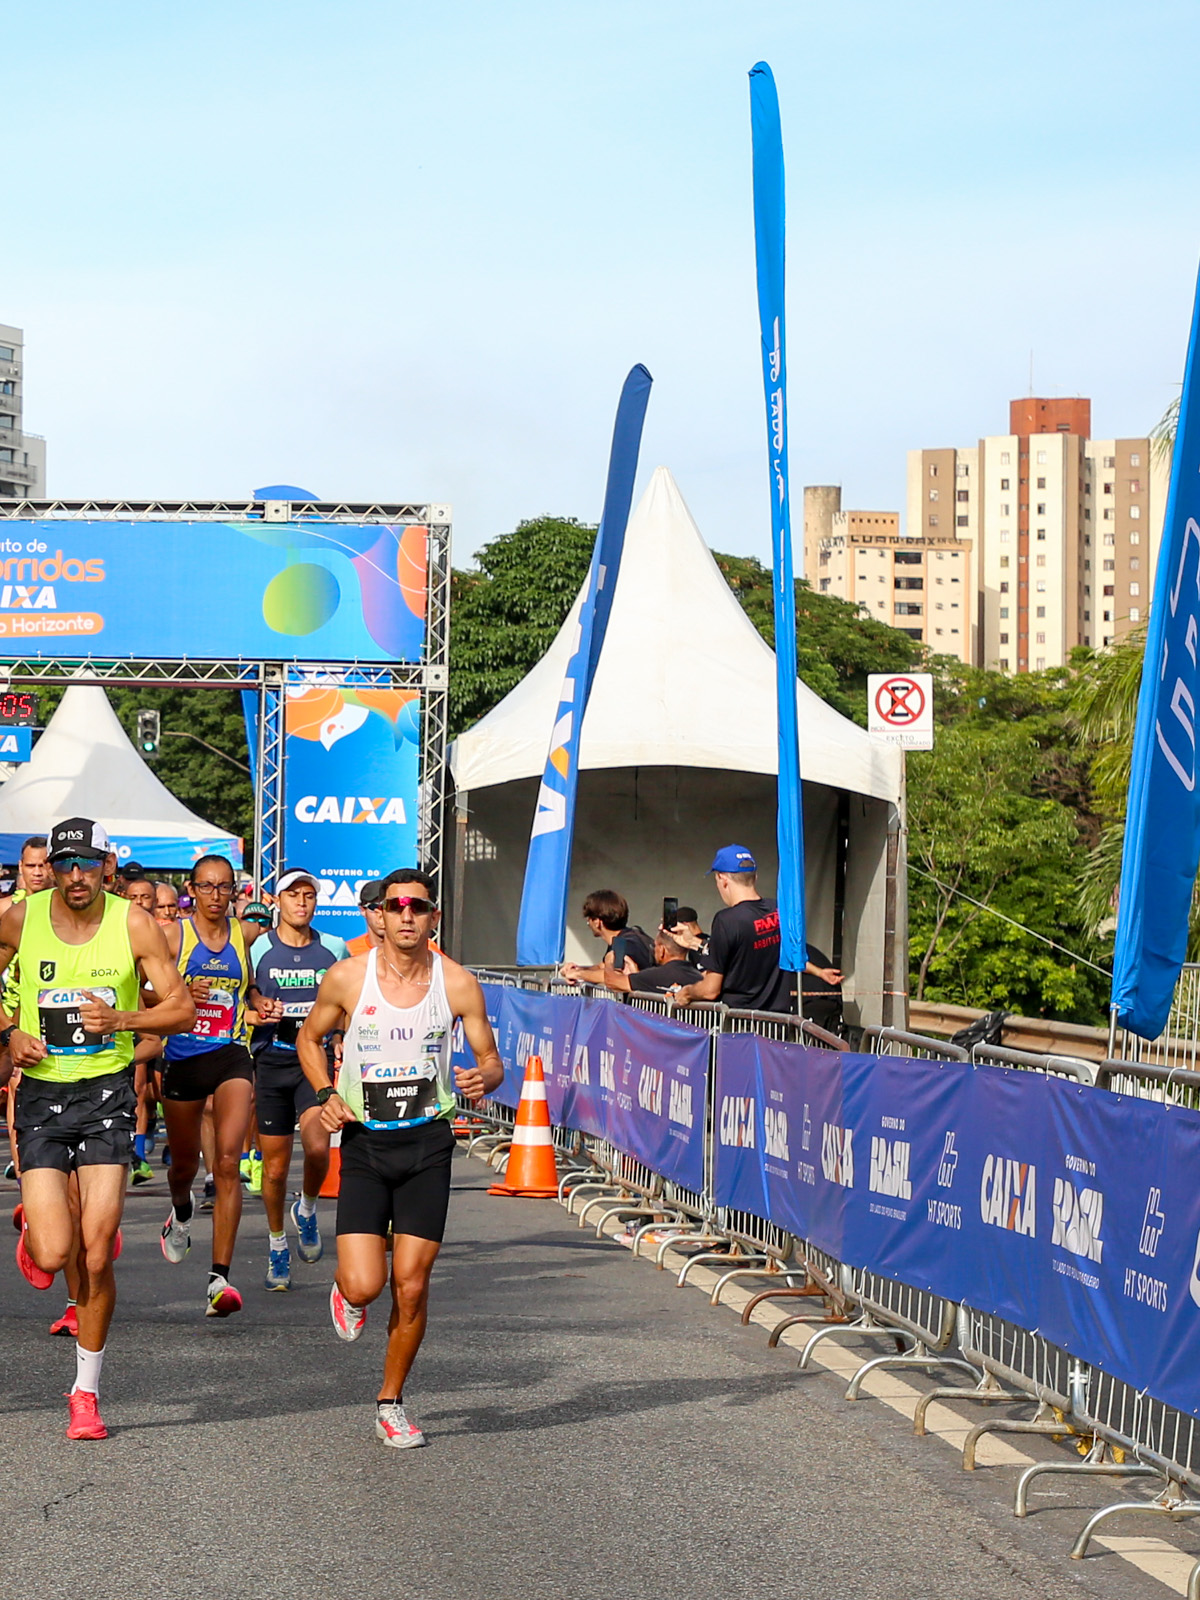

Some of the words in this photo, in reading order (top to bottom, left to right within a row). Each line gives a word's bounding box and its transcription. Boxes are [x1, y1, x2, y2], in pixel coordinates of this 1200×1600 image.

[26, 538, 48, 553] de
[12, 615, 95, 633] Horizonte
[294, 796, 407, 824] CAIXA
[67, 830, 84, 839] IVS
[320, 868, 363, 877] GOVERNO
[367, 869, 380, 877] DO
[91, 969, 120, 977] BORA
[202, 963, 229, 971] CASSEMS
[72, 1027, 86, 1045] 6
[375, 1066, 418, 1078] CAIXA
[386, 1086, 419, 1098] ANDRE
[395, 1100, 408, 1118] 7
[720, 1095, 755, 1150] CAIXA
[869, 1136, 913, 1201] BRASIL
[980, 1153, 1036, 1239] CAIXA
[927, 1199, 938, 1223] HT
[937, 1201, 962, 1231] SPORTS
[1051, 1177, 1104, 1265] BRASIL
[1123, 1267, 1137, 1298] HT
[1136, 1272, 1168, 1313] SPORTS
